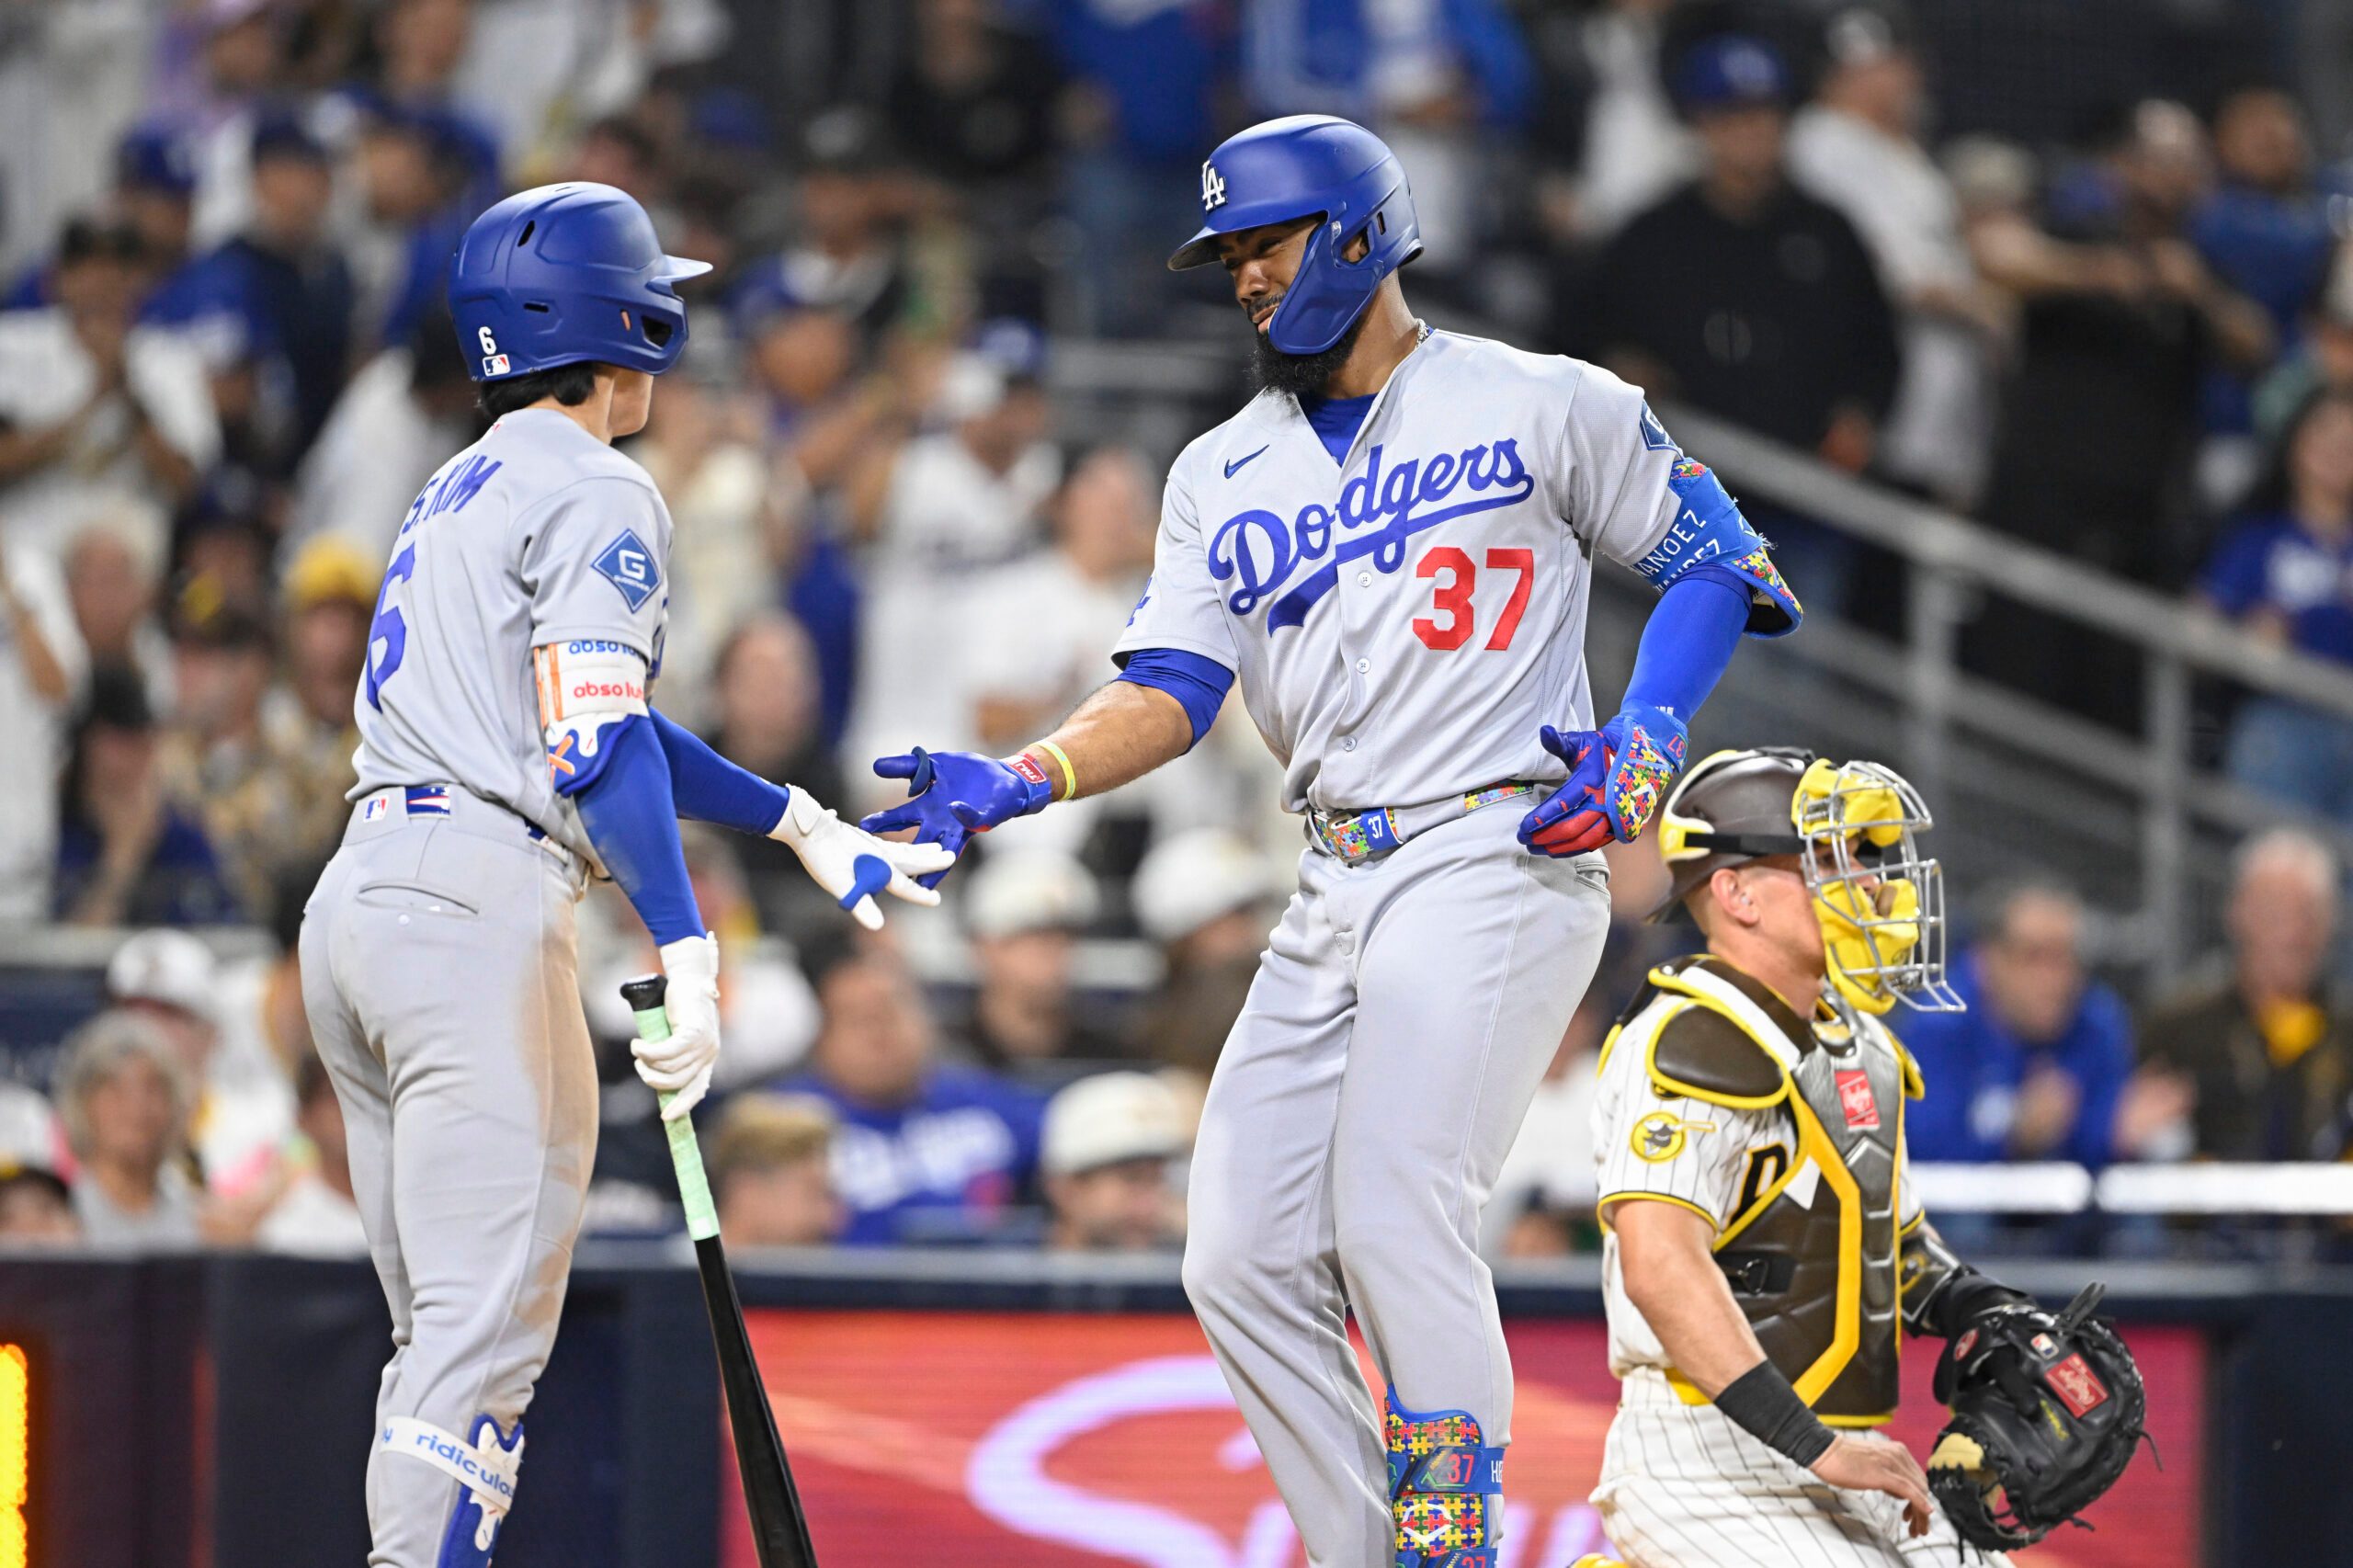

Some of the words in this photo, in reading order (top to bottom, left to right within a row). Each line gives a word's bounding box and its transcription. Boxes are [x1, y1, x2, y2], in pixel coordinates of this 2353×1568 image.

[1202, 160, 1225, 210] LA
[478, 326, 496, 355] 6
[1209, 437, 1534, 634] Dodgers
[619, 549, 645, 581] G
[1413, 546, 1534, 651] 37
[367, 540, 415, 714] 6
[1368, 814, 1383, 839] 37
[1448, 1453, 1475, 1484] 37
